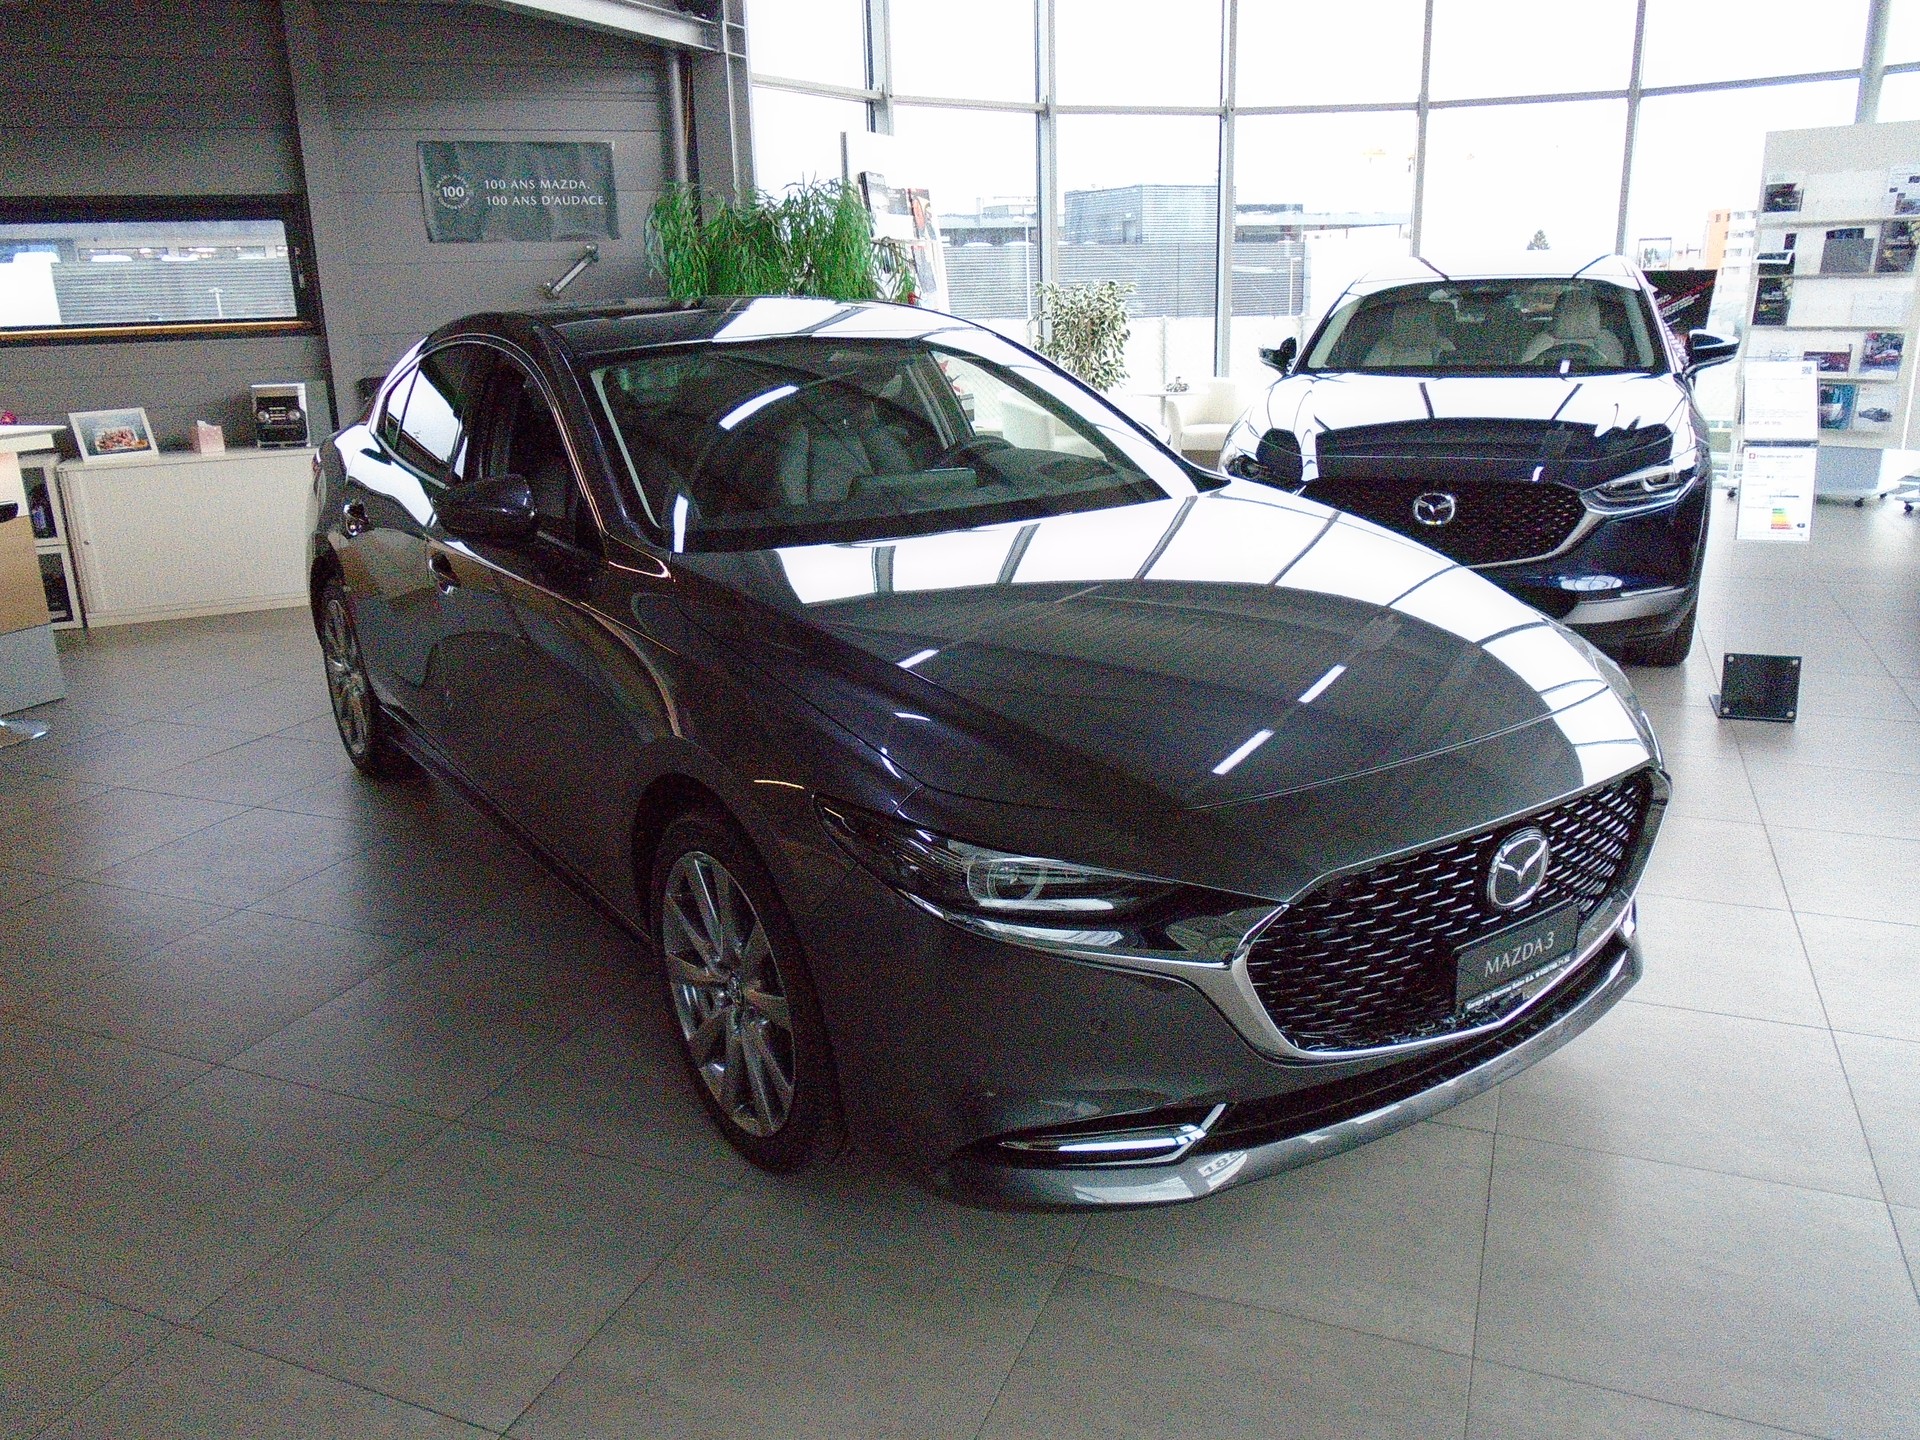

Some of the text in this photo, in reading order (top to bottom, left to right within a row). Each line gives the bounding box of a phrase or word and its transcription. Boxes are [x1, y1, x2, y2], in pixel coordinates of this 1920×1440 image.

[484, 179, 506, 190] 100
[510, 179, 535, 190] ANS
[540, 179, 591, 190] MAZDA.
[441, 186, 465, 198] 100
[486, 195, 608, 206] 100 ANS D'AUDACE.
